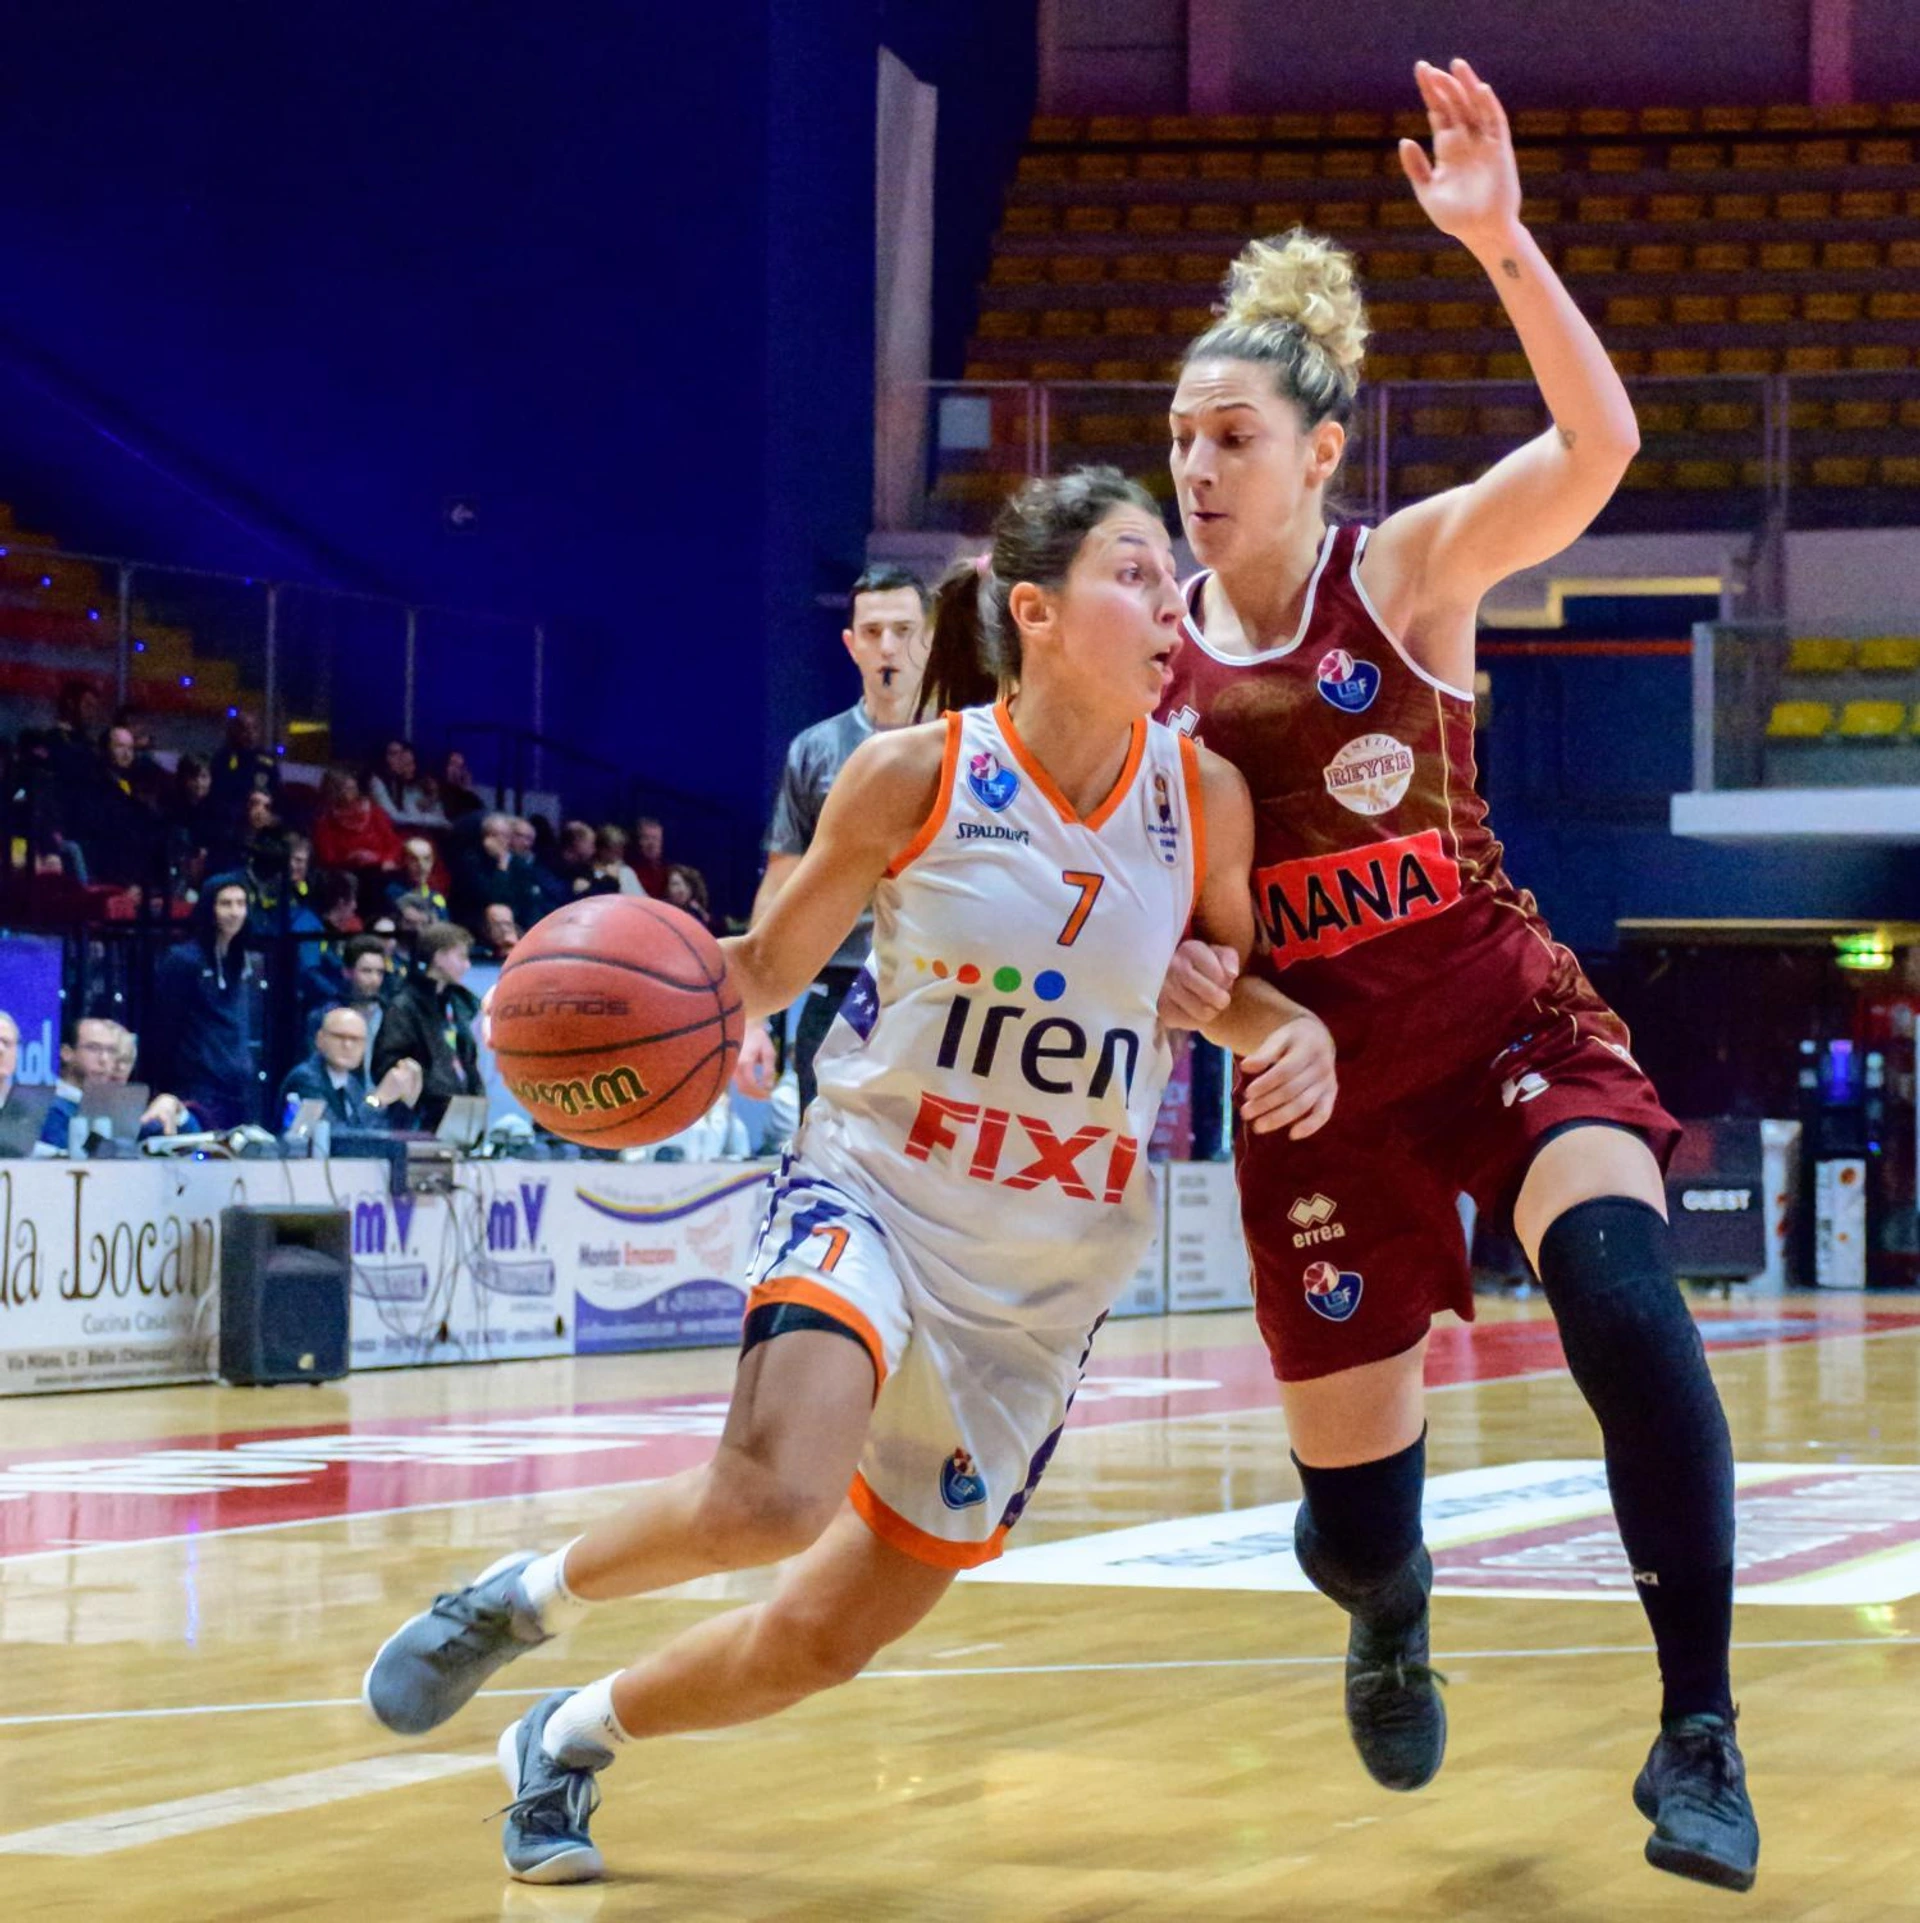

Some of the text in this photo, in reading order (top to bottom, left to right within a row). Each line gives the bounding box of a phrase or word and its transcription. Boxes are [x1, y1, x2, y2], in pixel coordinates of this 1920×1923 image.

[1328, 750, 1412, 788] REYER
[1057, 870, 1105, 947] 7
[60, 1169, 246, 1300] Locan
[812, 1225, 851, 1272] 7
